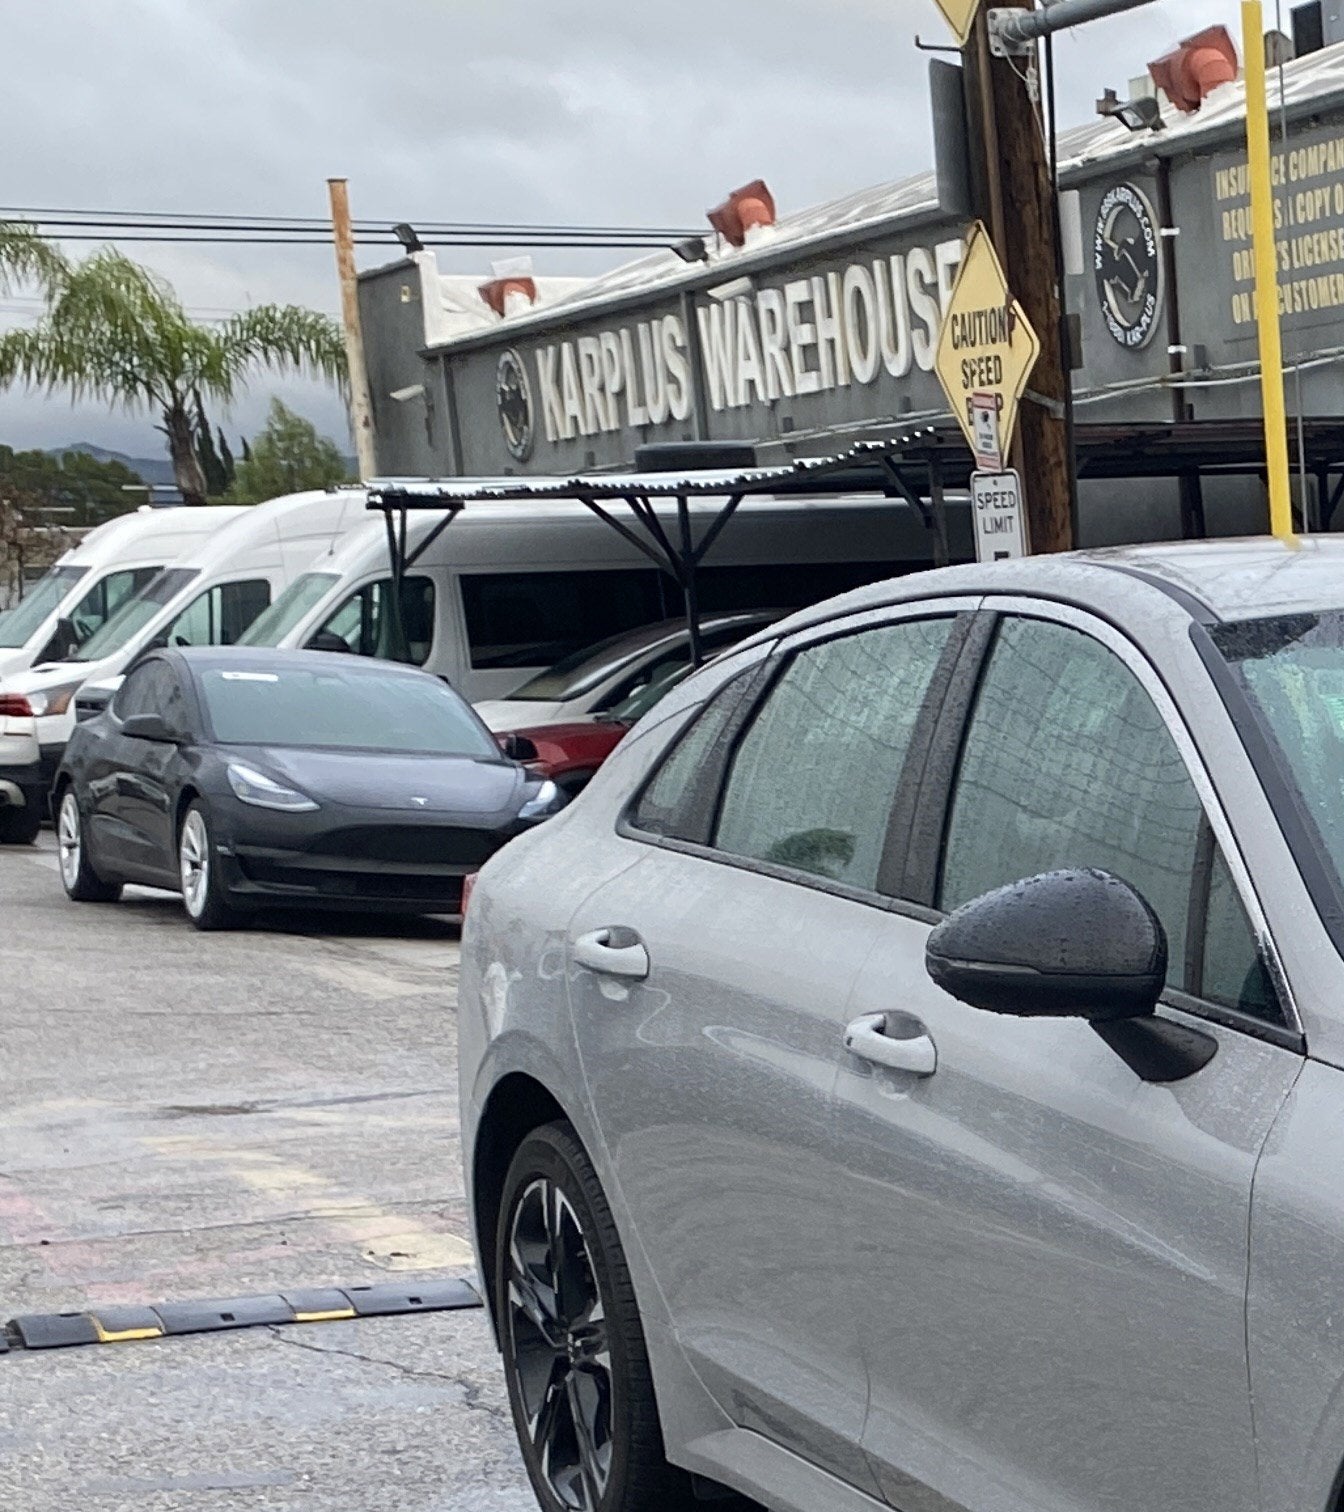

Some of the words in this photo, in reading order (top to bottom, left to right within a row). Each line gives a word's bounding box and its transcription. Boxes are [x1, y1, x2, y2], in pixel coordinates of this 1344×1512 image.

[1215, 154, 1286, 200] INSUCE
[1222, 198, 1282, 241] REQUS
[1296, 186, 1331, 224] COPY
[951, 305, 1007, 350] CAUTION
[1232, 292, 1251, 324] ON
[535, 314, 693, 442] KARPLUS
[961, 354, 1002, 389] SPEED
[977, 491, 1016, 510] SPEED
[983, 516, 1014, 534] LIMIT
